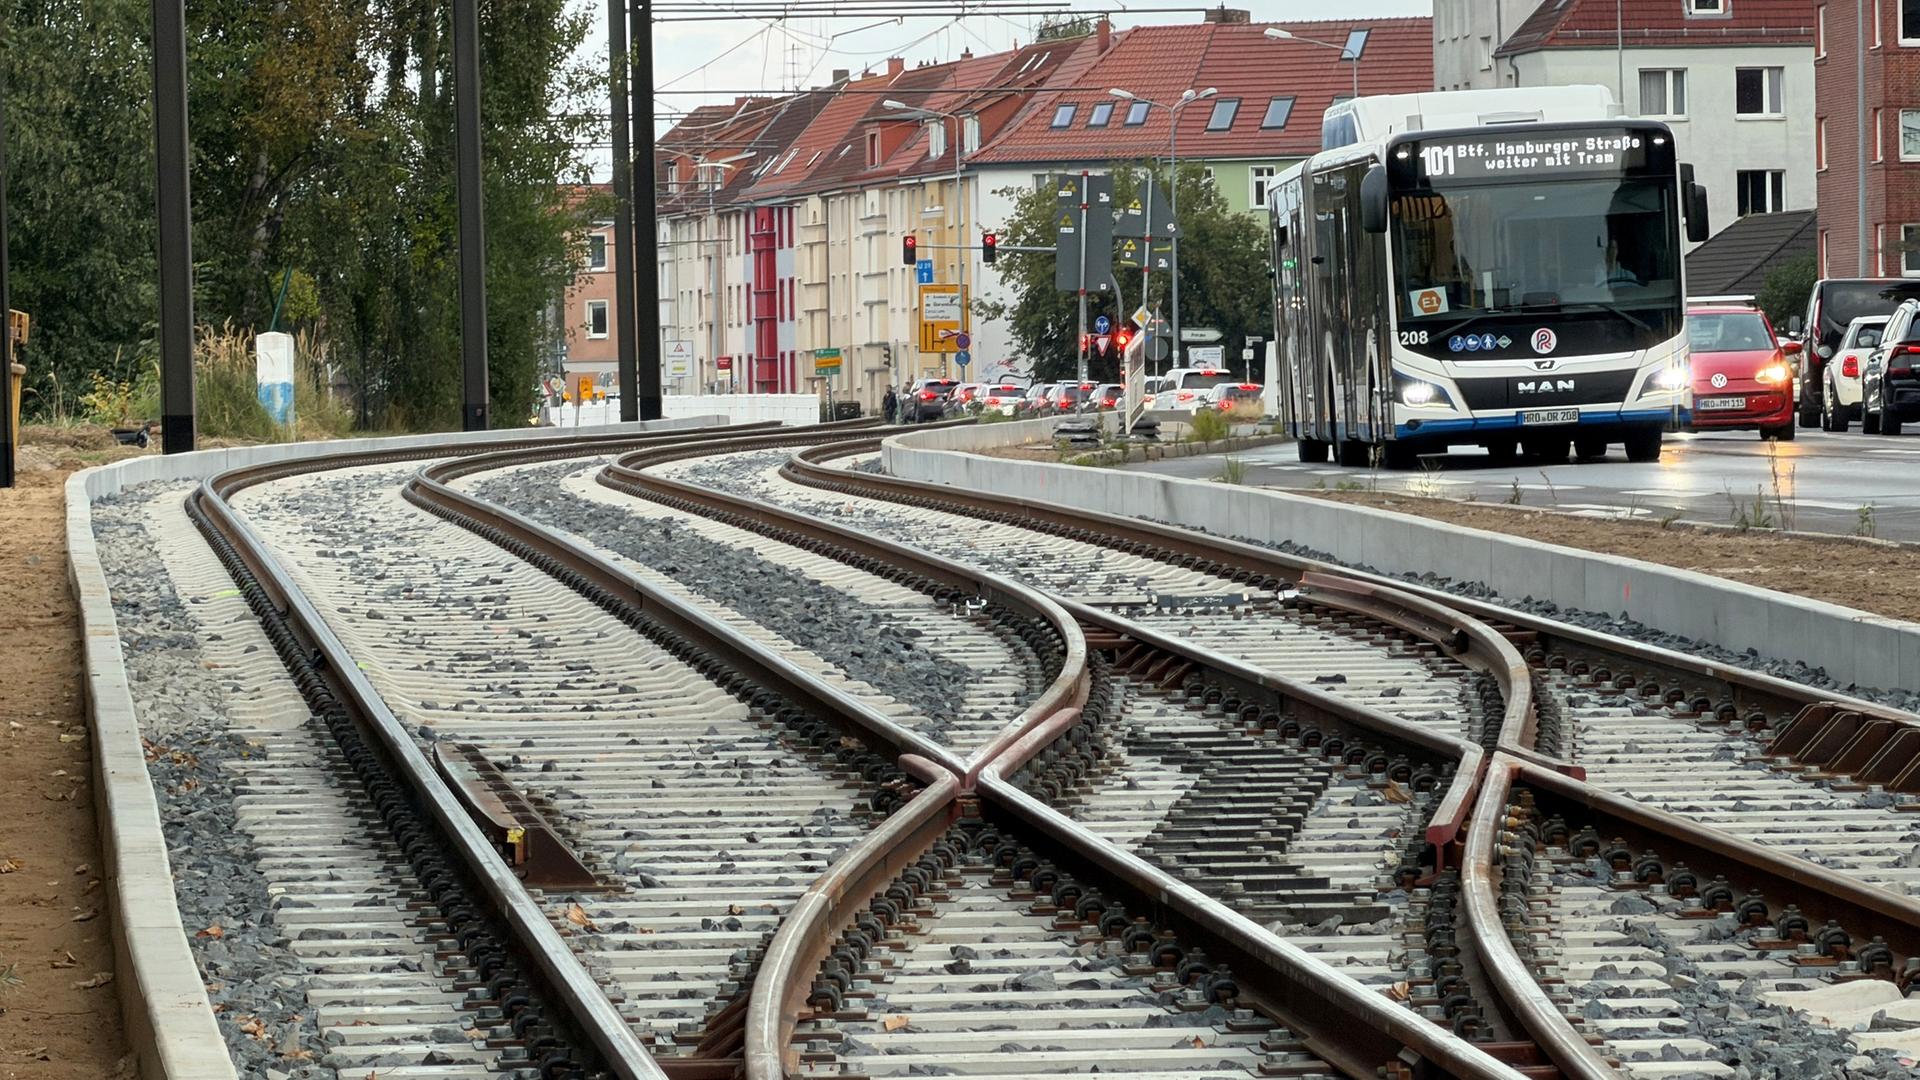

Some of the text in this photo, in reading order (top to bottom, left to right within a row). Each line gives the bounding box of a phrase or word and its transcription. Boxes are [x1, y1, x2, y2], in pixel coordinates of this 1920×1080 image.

[1457, 135, 1640, 157] Btf. Hamburger Straße
[1419, 145, 1455, 176] 101
[1485, 151, 1614, 170] weiter mit Tram
[1422, 297, 1439, 308] E1
[1401, 331, 1429, 345] 208
[1518, 380, 1575, 393] MAN
[1523, 412, 1540, 422] HRO
[1560, 410, 1577, 421] 208
